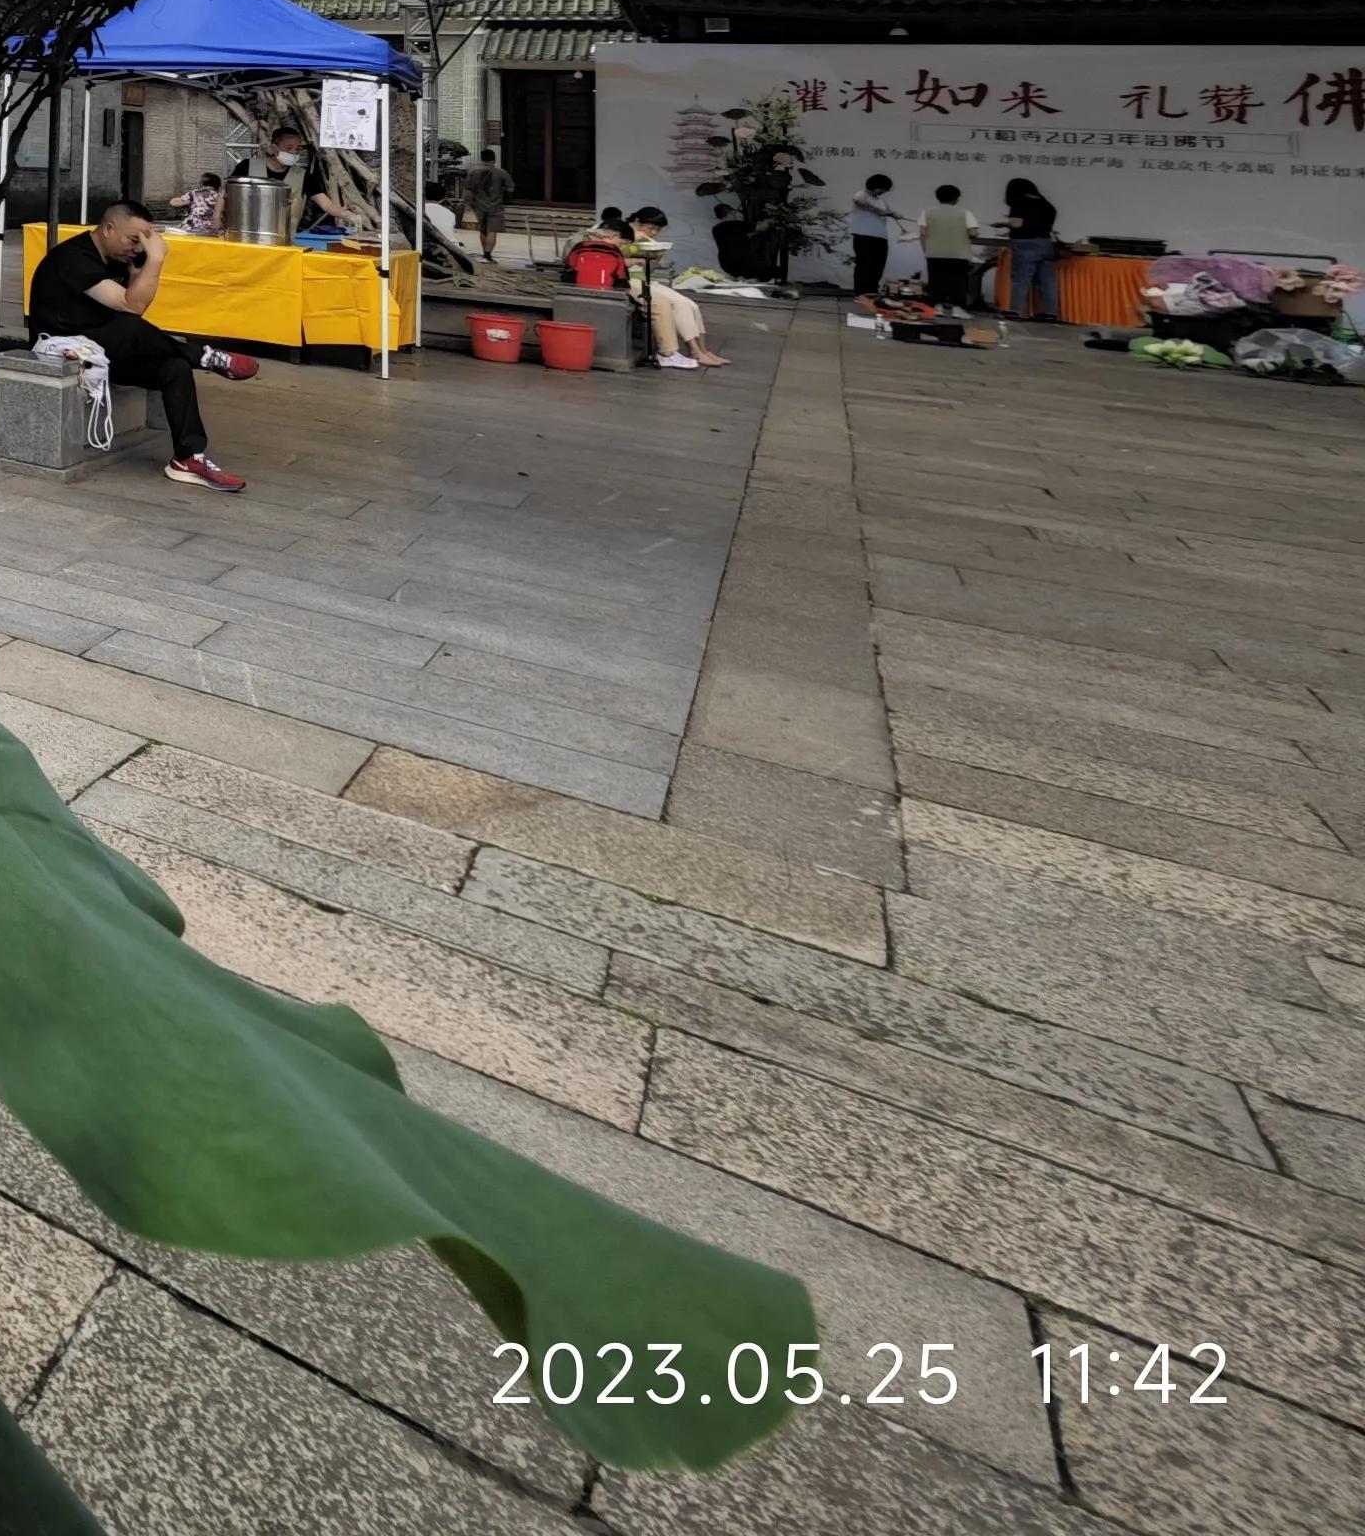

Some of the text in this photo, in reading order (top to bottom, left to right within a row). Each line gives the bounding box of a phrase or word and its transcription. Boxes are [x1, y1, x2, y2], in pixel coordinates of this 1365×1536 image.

[782, 68, 1365, 133] 灌沐如来 礼赞佛
